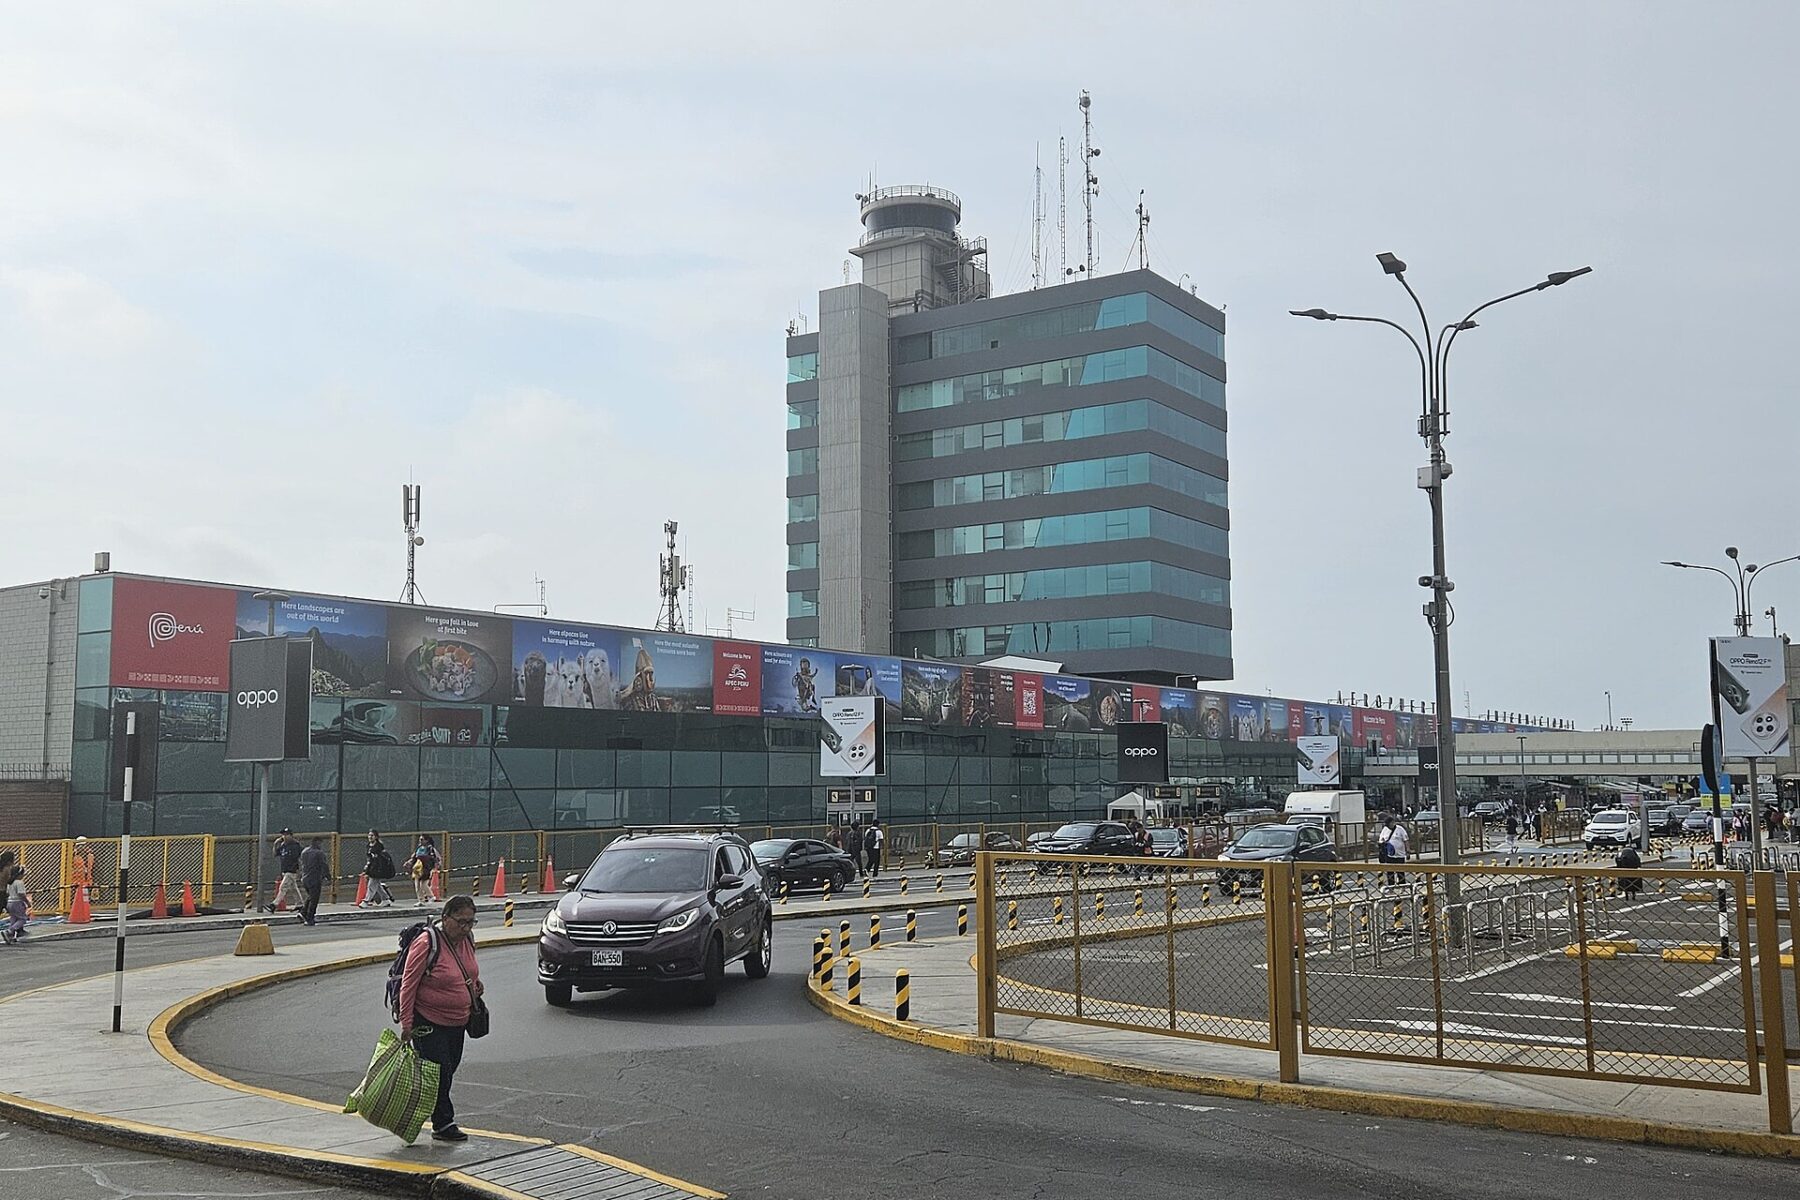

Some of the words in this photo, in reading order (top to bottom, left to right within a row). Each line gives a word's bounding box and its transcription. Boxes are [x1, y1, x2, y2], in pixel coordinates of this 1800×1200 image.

[281, 601, 297, 610] Here
[297, 603, 334, 614] landscapes
[334, 607, 345, 615] are
[286, 612, 298, 620] out
[299, 612, 306, 621] of
[307, 613, 319, 621] this
[320, 615, 340, 623] world
[425, 616, 438, 624] Here
[237, 689, 278, 709] oppo
[1336, 690, 1436, 714] AEROPUERT
[1124, 747, 1157, 757] oppo
